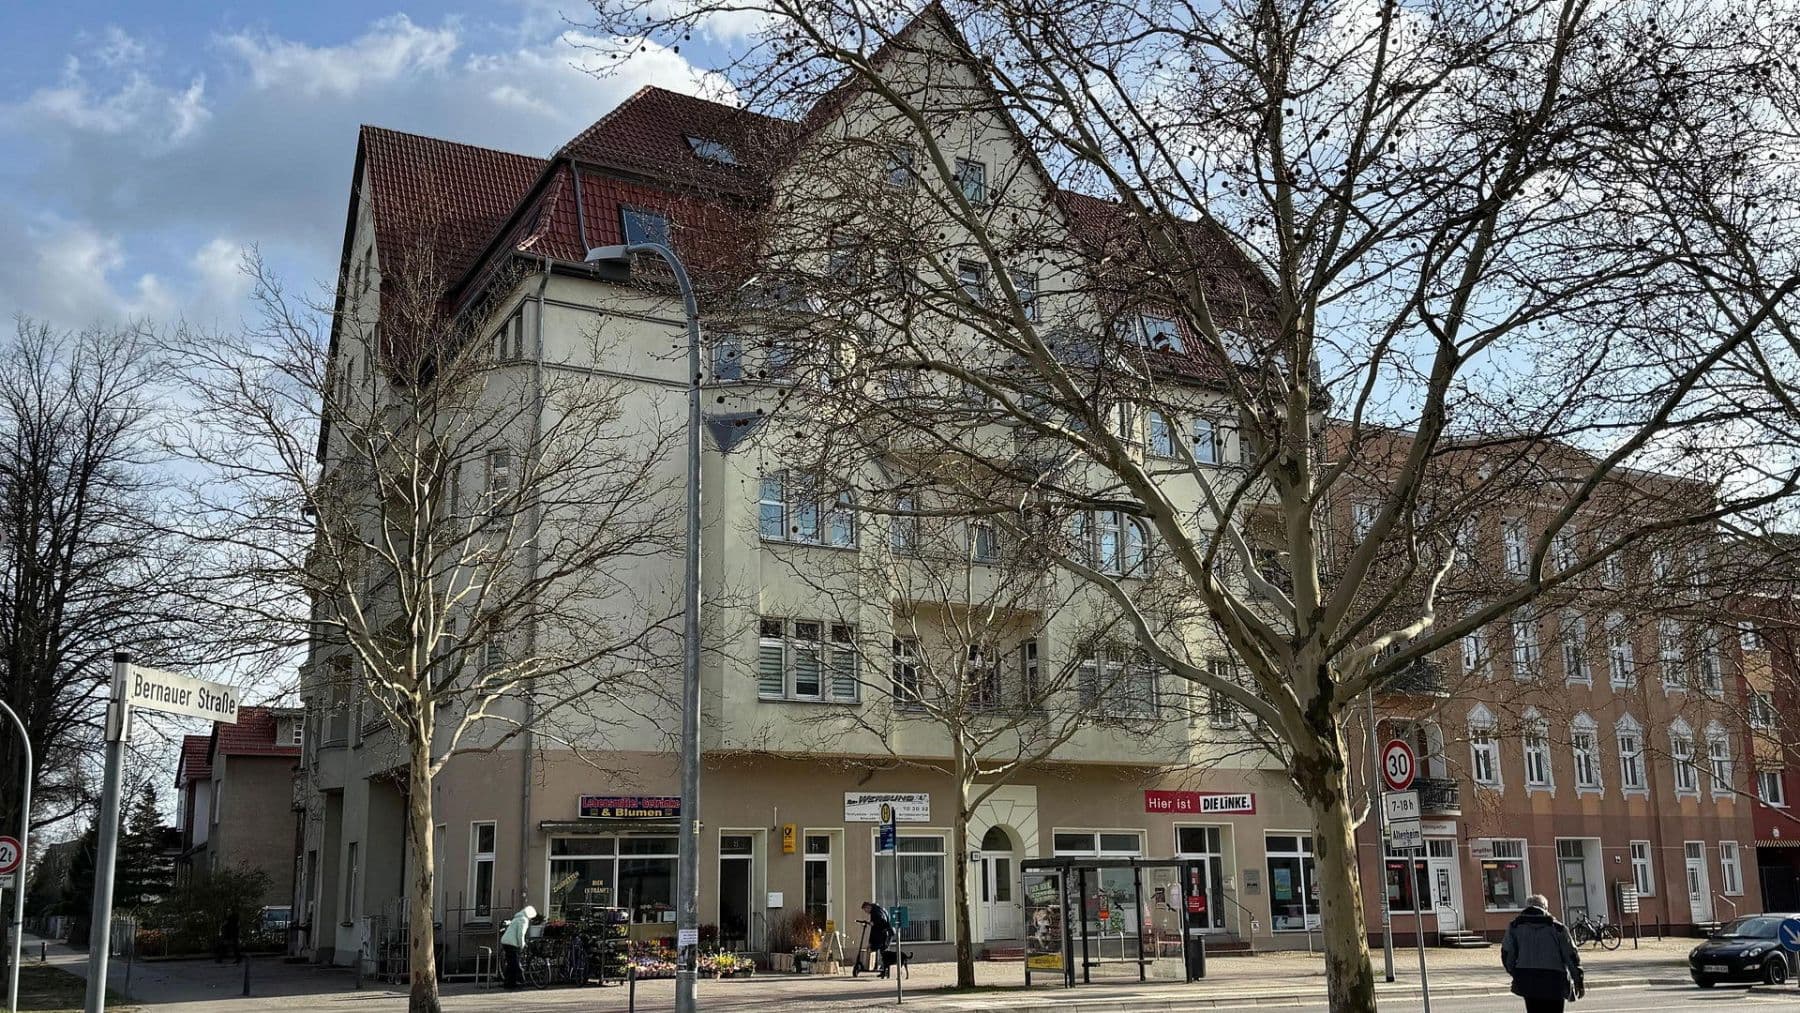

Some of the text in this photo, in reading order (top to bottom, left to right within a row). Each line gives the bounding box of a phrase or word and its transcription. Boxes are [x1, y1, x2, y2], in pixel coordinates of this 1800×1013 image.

[134, 673, 236, 715] Bernauer Straße
[1388, 753, 1408, 777] 30
[601, 808, 662, 816] & Blumen
[1149, 798, 1172, 809] Hier
[1177, 798, 1191, 809] ist
[1203, 797, 1218, 810] DIE
